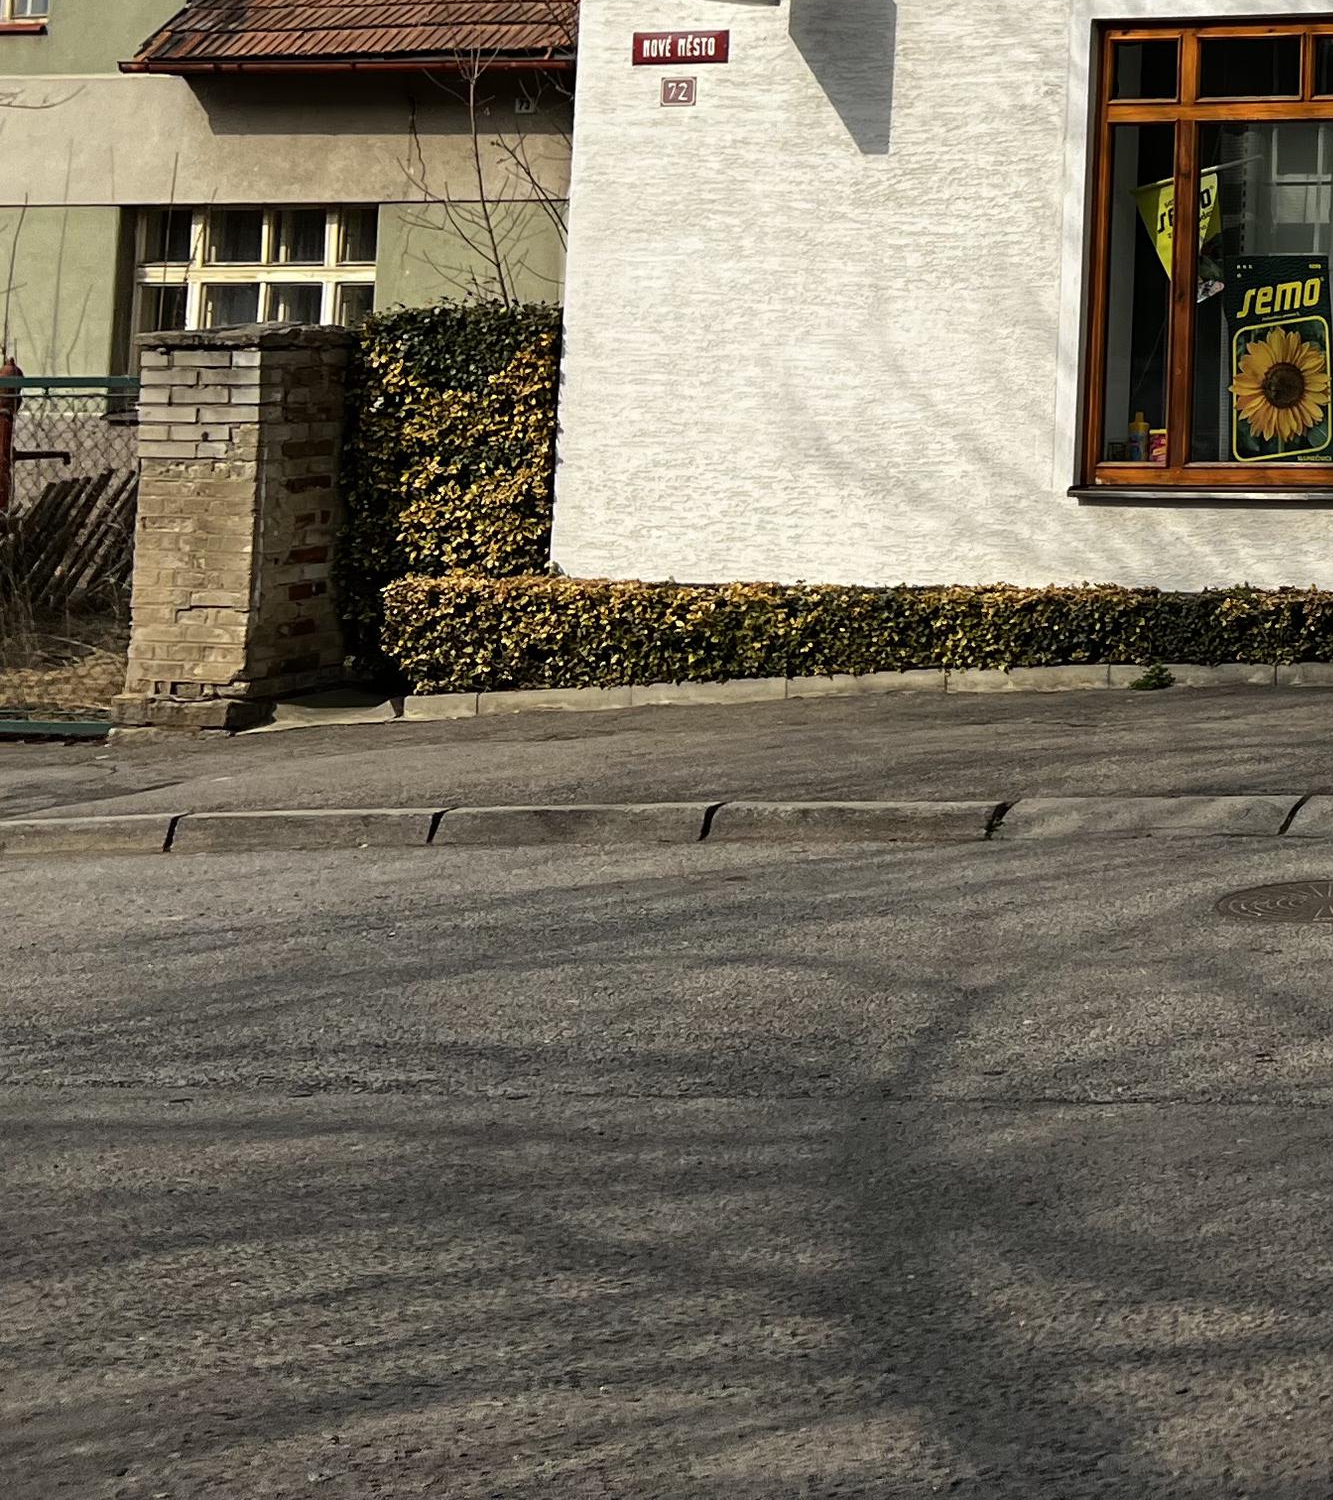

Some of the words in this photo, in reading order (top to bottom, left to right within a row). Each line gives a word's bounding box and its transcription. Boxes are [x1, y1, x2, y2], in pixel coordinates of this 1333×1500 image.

[643, 35, 672, 57] NOVÉ
[678, 34, 716, 57] MĚSTO
[668, 82, 689, 101] 72
[1236, 277, 1321, 319] semo
